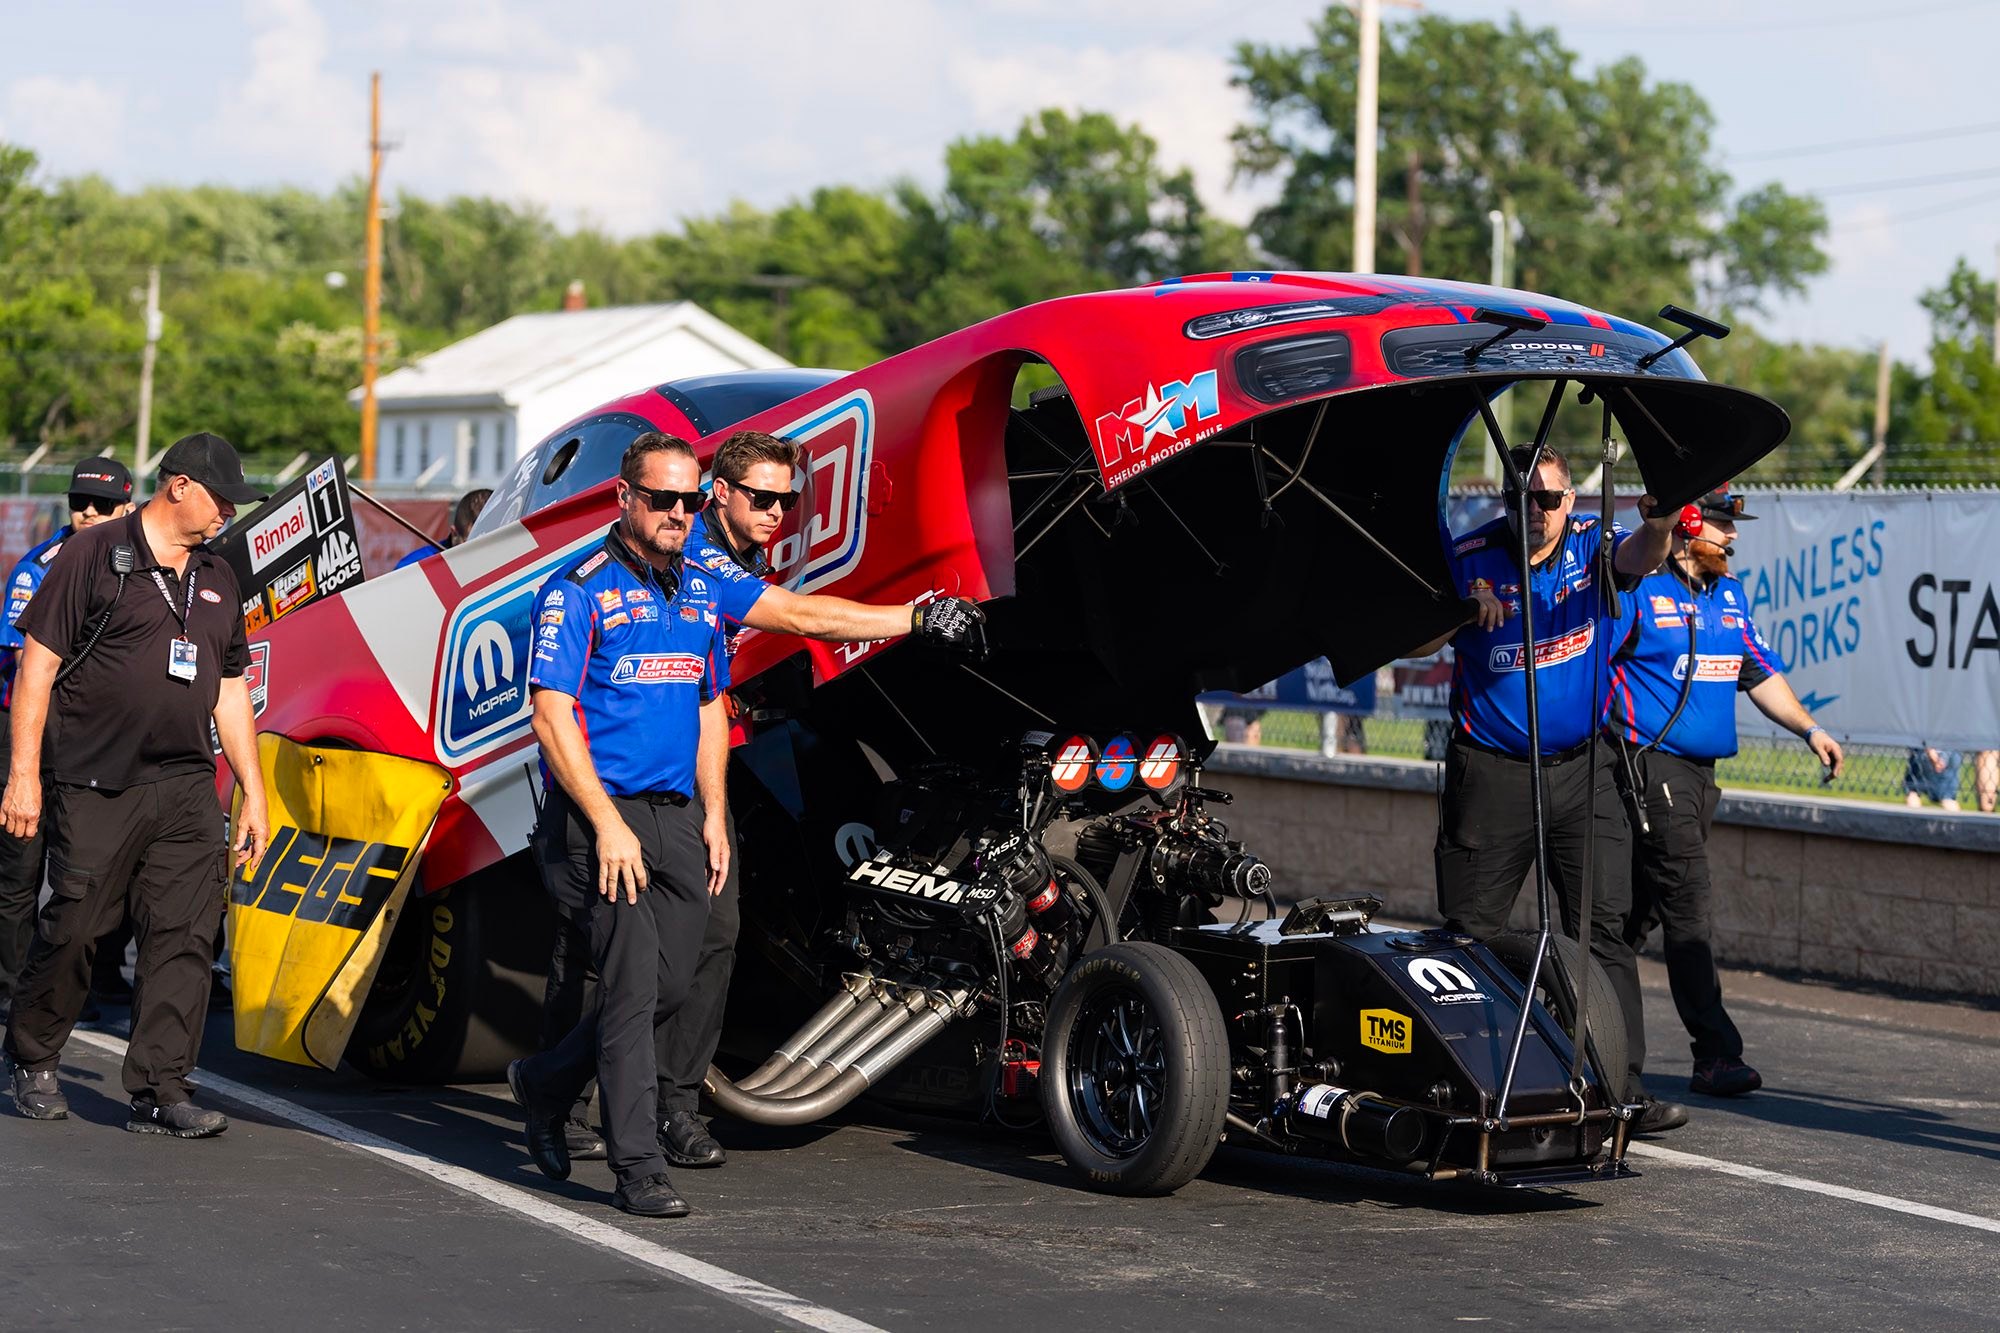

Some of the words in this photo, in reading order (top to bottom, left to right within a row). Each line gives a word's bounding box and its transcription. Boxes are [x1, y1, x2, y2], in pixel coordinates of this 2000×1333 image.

[1511, 343, 1586, 351] DODGE
[309, 462, 334, 491] Mobil
[1109, 460, 1148, 488] SHELOR
[1151, 437, 1192, 464] MOTOR
[319, 487, 333, 525] 1
[254, 505, 305, 561] Rinnai
[317, 530, 359, 583] MAC
[1737, 521, 1885, 618] AINLESS
[273, 562, 307, 600] RUSH
[318, 559, 361, 596] TOOLS
[1905, 573, 2000, 670] STA
[642, 660, 698, 670] direct
[468, 686, 519, 721] MOPAR
[987, 836, 1020, 860] MSD
[230, 825, 409, 932] JEGS
[850, 861, 969, 904] HEMI
[966, 887, 997, 900] MSD
[368, 903, 455, 1070] ODYEAR
[1431, 992, 1488, 1003] MOPAR
[1366, 1016, 1406, 1042] TMS
[1368, 1036, 1405, 1050] TITANIUM
